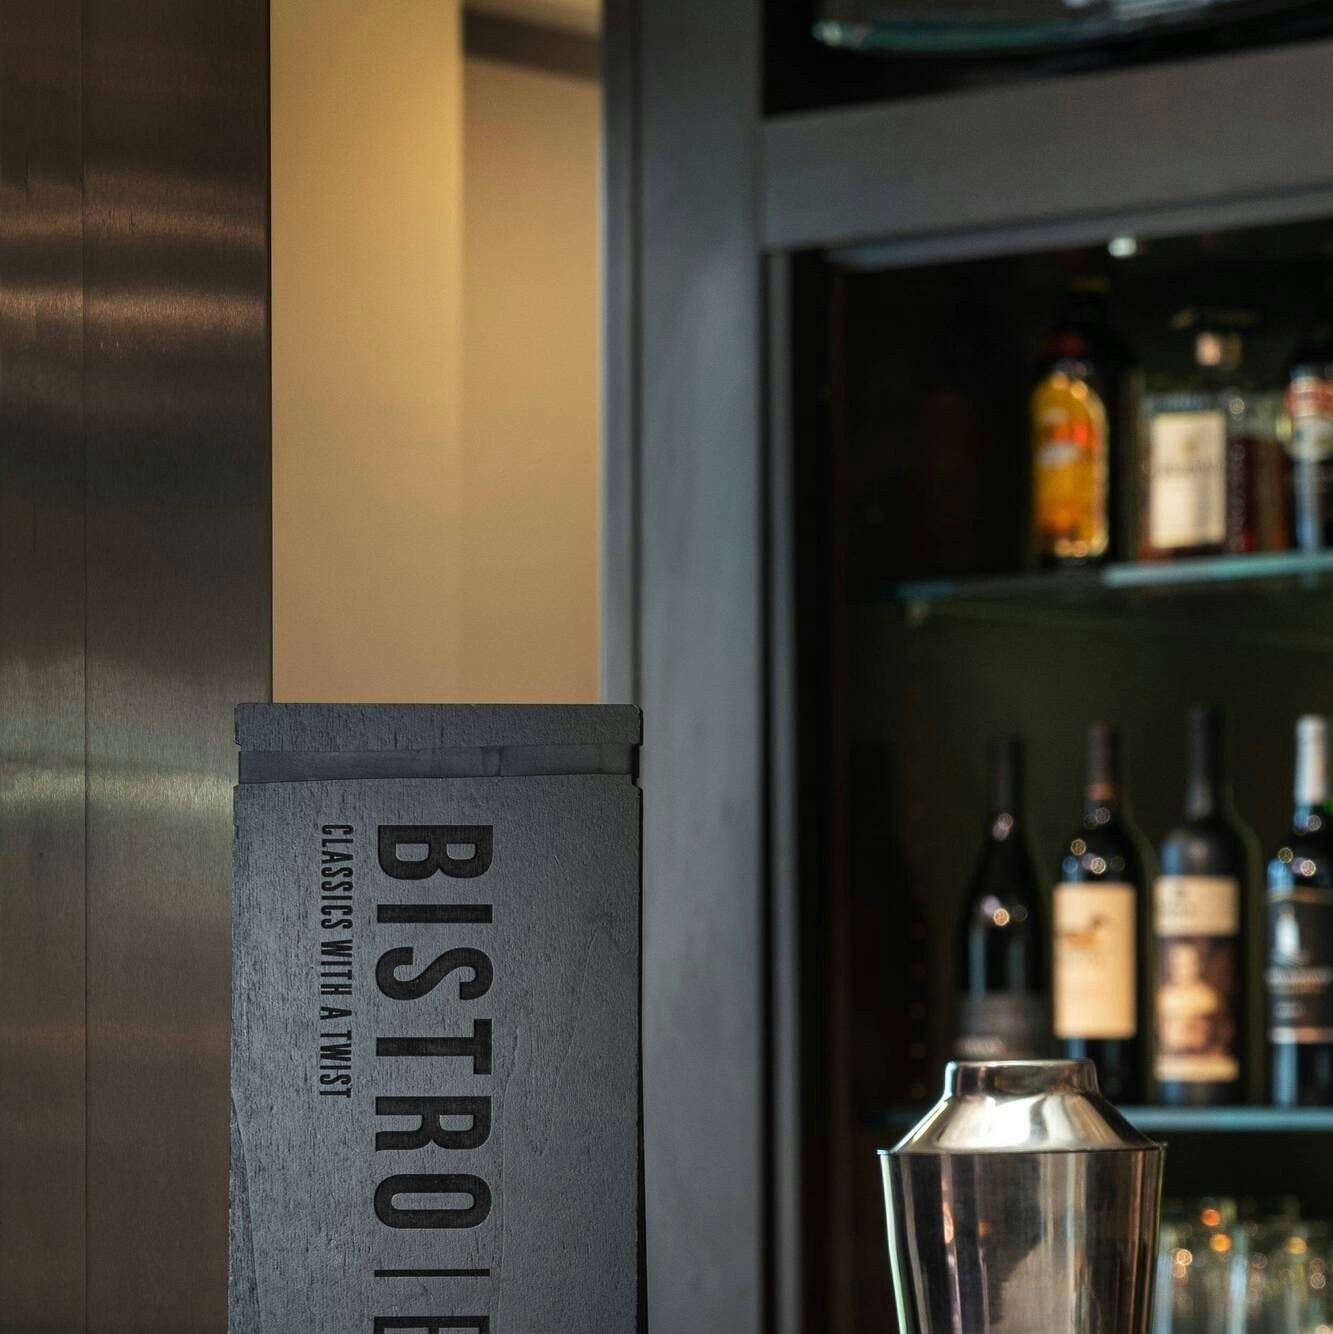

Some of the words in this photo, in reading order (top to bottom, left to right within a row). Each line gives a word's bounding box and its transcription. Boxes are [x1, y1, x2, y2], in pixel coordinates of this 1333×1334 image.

[320, 824, 353, 929] CLASSICS
[320, 939, 353, 996] WITH
[319, 1006, 352, 1021] A
[373, 824, 494, 1229] BISTRO
[319, 1030, 352, 1099] TWIST
